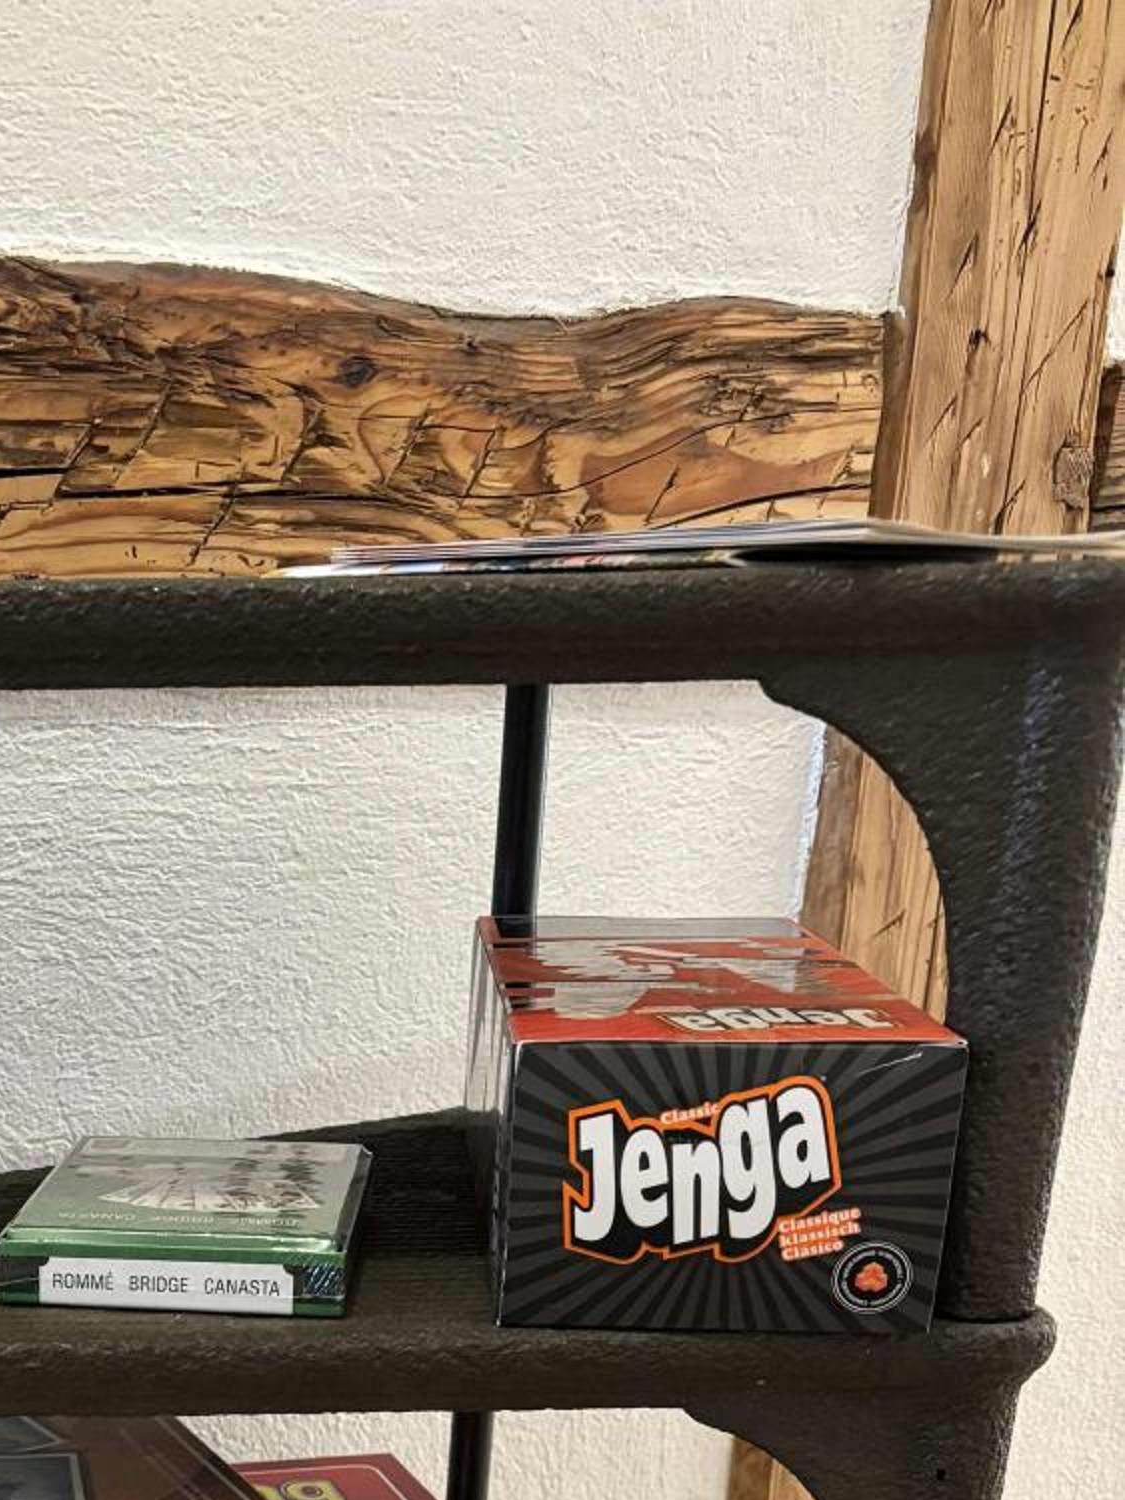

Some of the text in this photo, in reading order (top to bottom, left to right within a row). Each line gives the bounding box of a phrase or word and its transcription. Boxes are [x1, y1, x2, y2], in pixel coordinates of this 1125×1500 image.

[659, 1100, 720, 1126] Classic
[574, 1084, 831, 1247] Jenga
[778, 1207, 861, 1234] Classique
[51, 1270, 281, 1297] ROMMÉ BRIDGE CANASTA
